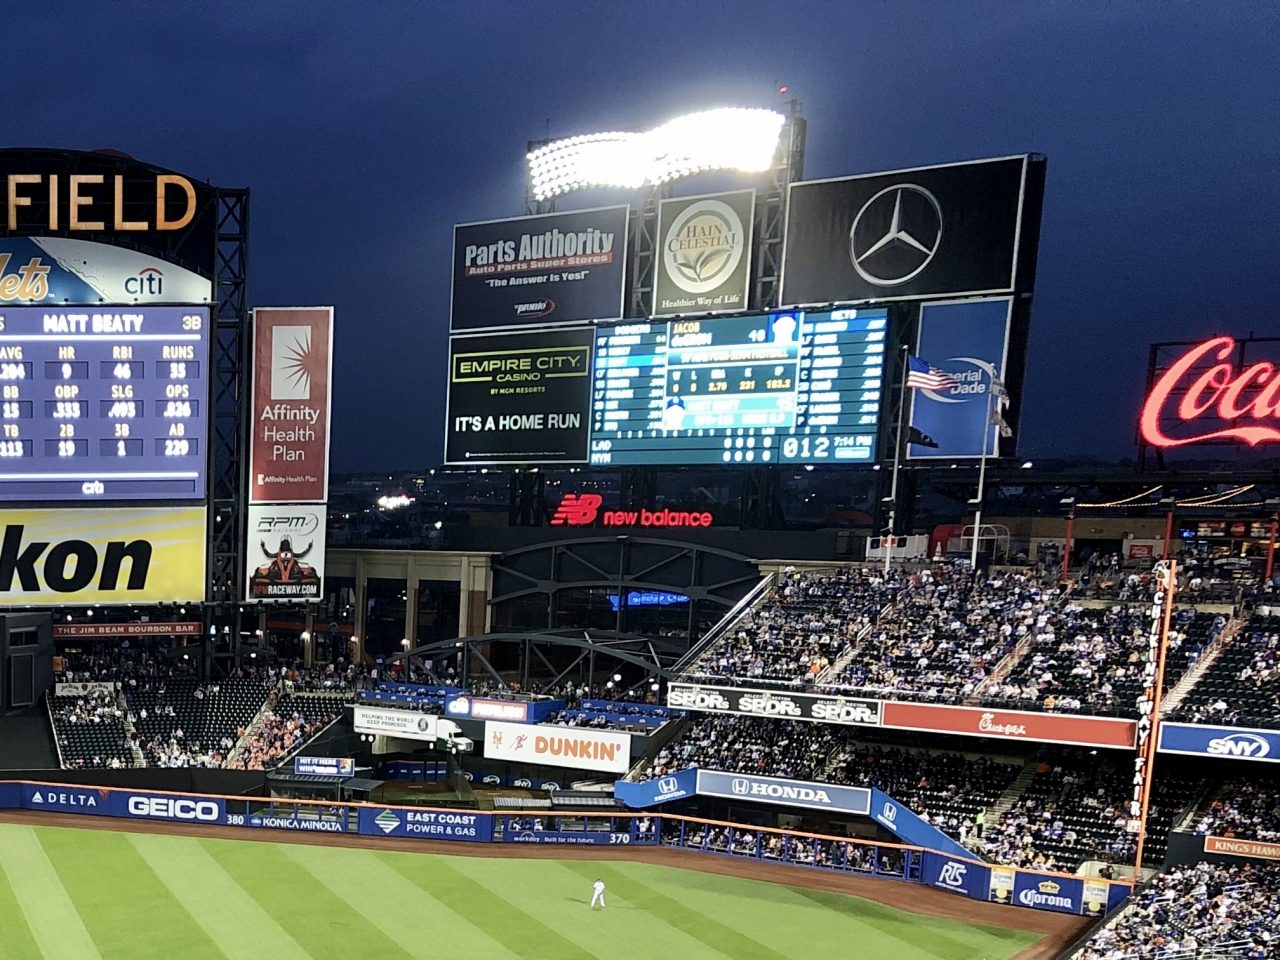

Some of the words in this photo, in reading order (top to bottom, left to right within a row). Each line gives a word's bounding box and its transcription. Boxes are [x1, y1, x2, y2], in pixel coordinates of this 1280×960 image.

[7, 174, 197, 231] FIELD
[687, 224, 723, 238] HAIN
[465, 240, 516, 267] Parts
[518, 228, 614, 261] Authority
[469, 267, 495, 275] Auto
[497, 263, 528, 272] Parts
[530, 260, 566, 269] Super
[568, 254, 608, 265] Stores
[125, 268, 163, 295] citi
[509, 275, 548, 286] Answer
[662, 299, 696, 308] Healthier
[697, 297, 713, 307] Way
[714, 296, 723, 304] of
[724, 295, 740, 303] Life
[43, 314, 89, 333] MATT
[92, 314, 144, 333] BEATY
[182, 316, 202, 330] 3B
[0, 346, 22, 360] AVG
[58, 346, 75, 360] HR
[112, 346, 133, 359] RBI
[163, 346, 194, 359] RUNS
[114, 363, 131, 379] 46
[460, 358, 531, 373] EMPIRE
[536, 355, 580, 369] CITY
[496, 371, 541, 383] CASINO
[3, 386, 19, 399] BB
[55, 385, 79, 398] OBP
[111, 385, 133, 398] SLG
[166, 384, 189, 397] OPS
[499, 387, 514, 395] MGM
[515, 386, 546, 394] RESORTS
[260, 405, 320, 425] Affinity
[455, 416, 482, 432] IT'S
[485, 417, 497, 430] A
[498, 414, 544, 430] HOME
[547, 413, 580, 429] RUN
[3, 424, 19, 437] TB
[59, 424, 74, 437] 2B
[115, 424, 129, 437] 3B
[169, 423, 185, 436] AB
[264, 426, 315, 442] Health
[272, 445, 305, 461] Plan
[264, 475, 286, 484] Affinity
[285, 475, 304, 484] Health
[304, 475, 317, 483] Plan
[258, 517, 306, 527] RPM
[603, 510, 638, 527] new
[640, 508, 713, 527] balance
[535, 735, 621, 762] DUNKIN'
[1207, 737, 1261, 757] SNY
[48, 792, 97, 807] DELTA
[654, 790, 686, 801] HONDA
[751, 782, 831, 803] HONDA
[128, 795, 219, 820] GEICO
[226, 814, 244, 825] 380
[262, 817, 300, 829] KONICA
[300, 820, 342, 833] MINOLTA
[406, 812, 436, 822] EAST
[438, 813, 476, 825] COAST
[406, 824, 443, 834] POWER
[445, 826, 452, 835] &
[455, 826, 476, 836] GAS
[609, 833, 630, 844] 370
[1215, 841, 1249, 852] KINGS
[938, 861, 968, 886] RTS
[1019, 889, 1073, 908] Corona
